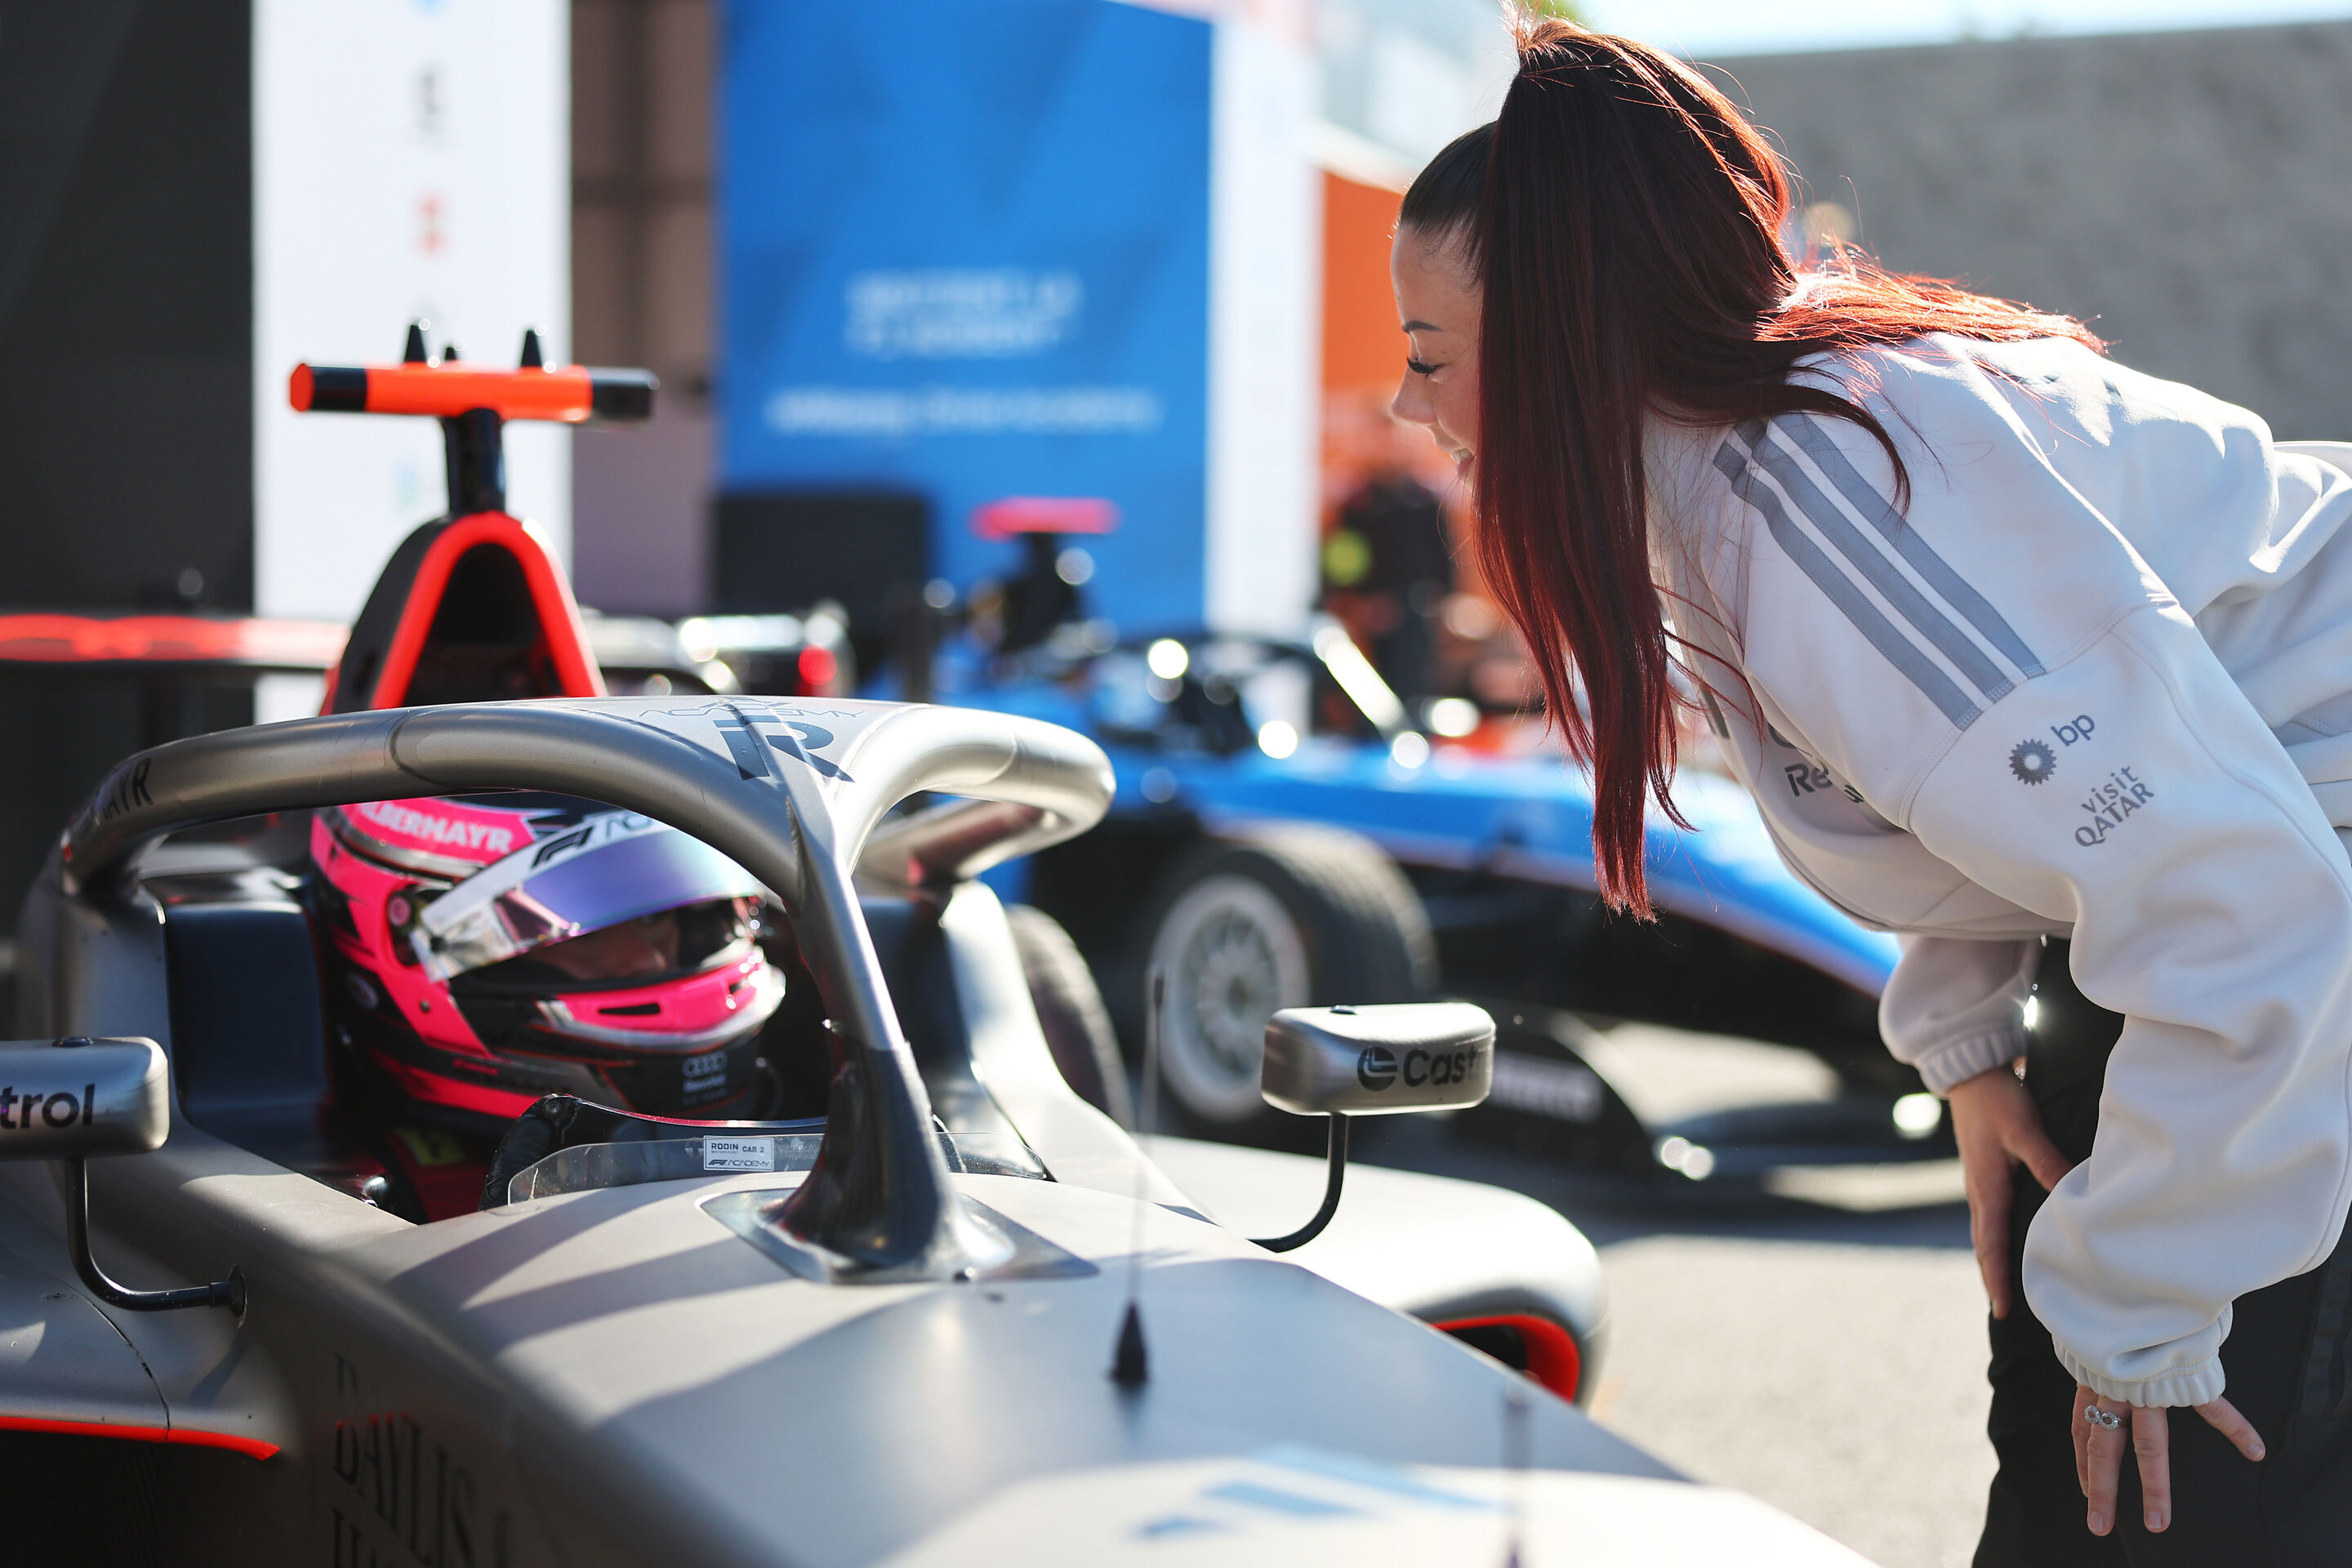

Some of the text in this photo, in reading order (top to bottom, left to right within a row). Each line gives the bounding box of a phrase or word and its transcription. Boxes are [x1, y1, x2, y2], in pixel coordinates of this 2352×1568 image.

[2051, 715, 2095, 746] bp
[2081, 766, 2138, 813] visit
[2074, 782, 2154, 847] QATAR
